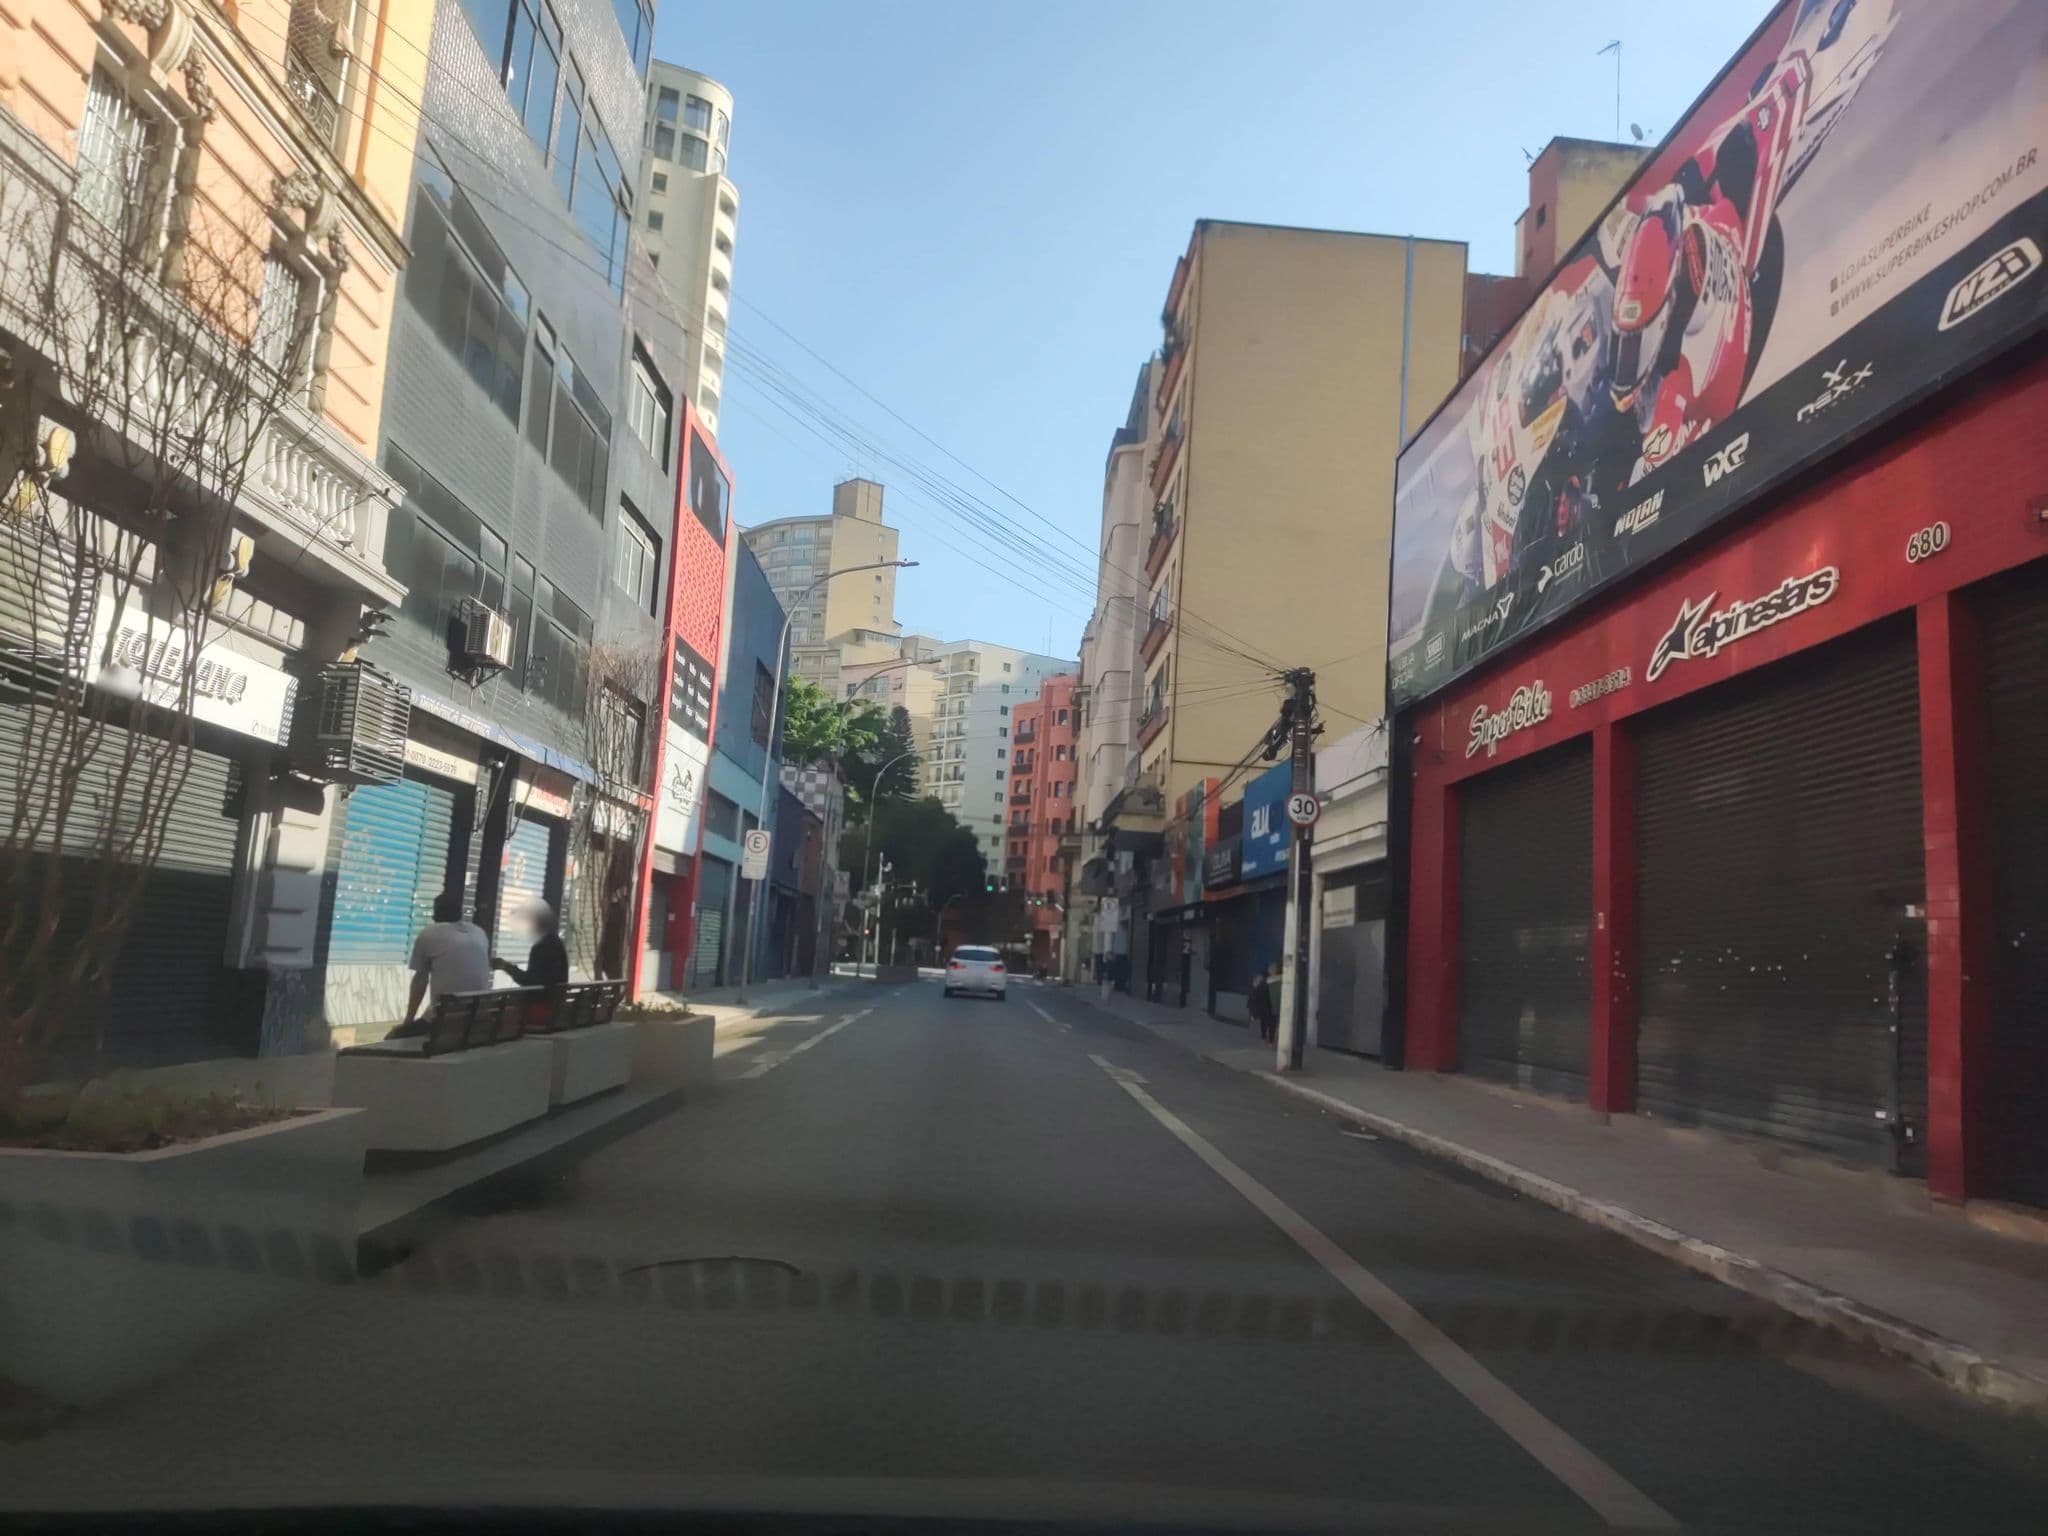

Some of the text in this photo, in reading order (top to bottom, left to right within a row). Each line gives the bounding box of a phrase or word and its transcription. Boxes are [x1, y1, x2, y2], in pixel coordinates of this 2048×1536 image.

[1613, 488, 1665, 538] NOLAN
[1554, 541, 1584, 577] cardo
[1905, 520, 1950, 564] 680
[1292, 798, 1315, 816] 30
[753, 836, 762, 849] E
